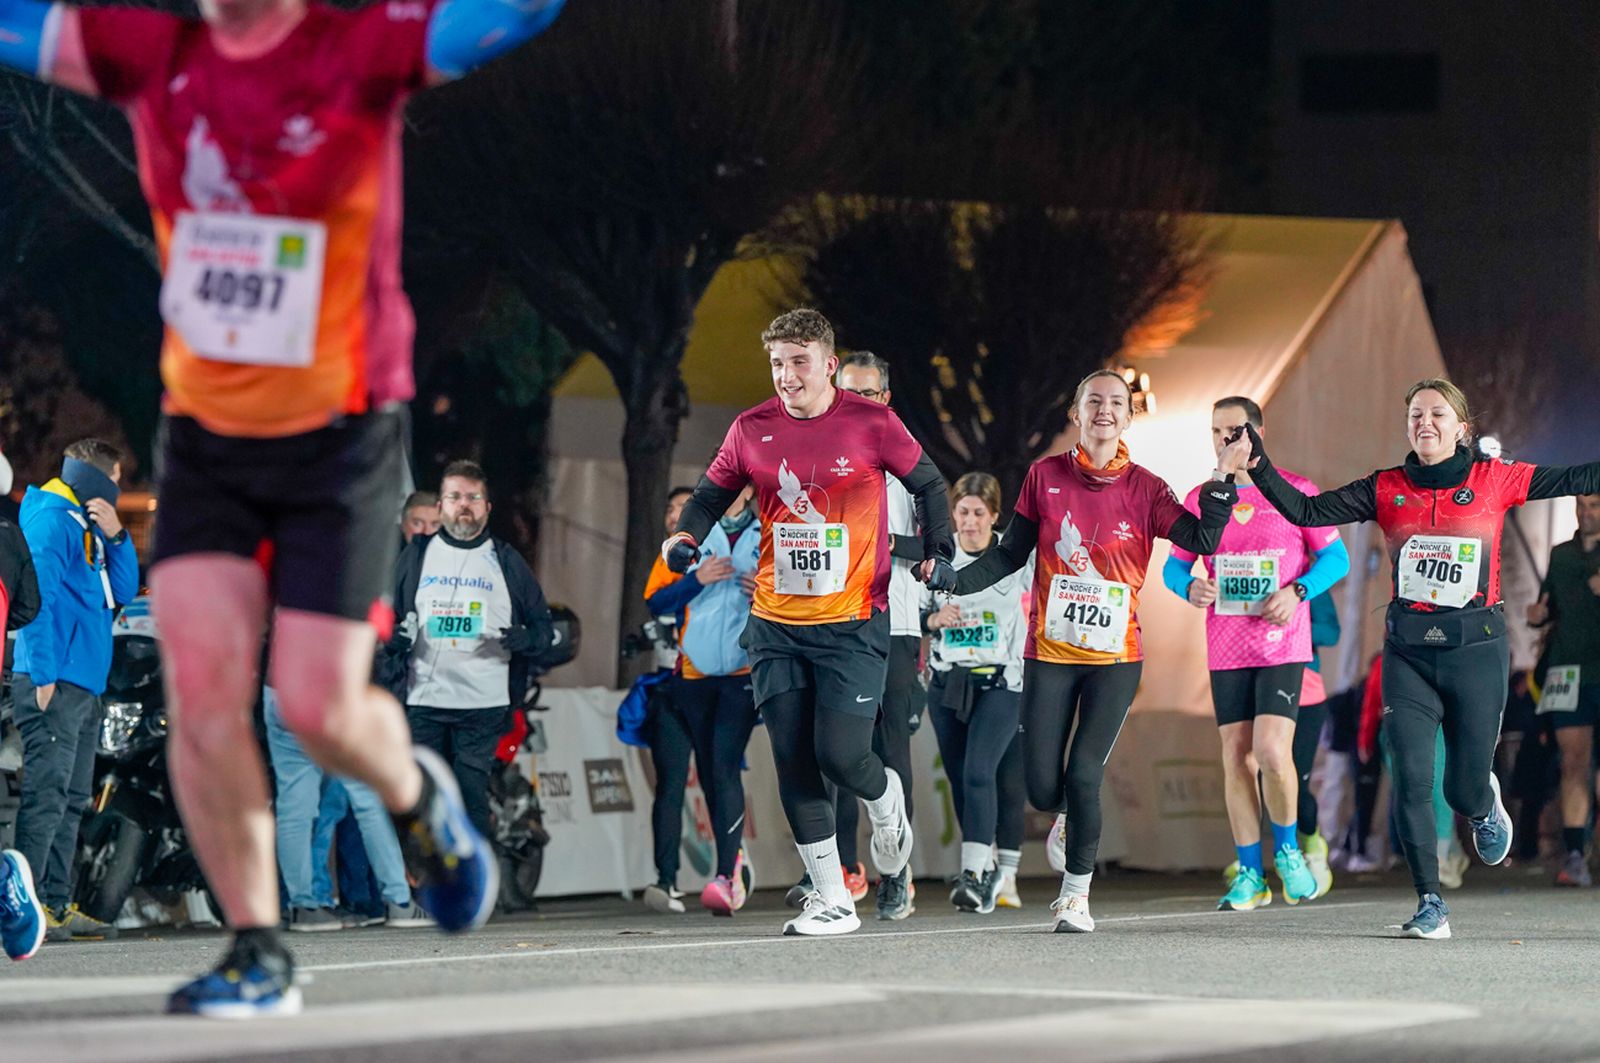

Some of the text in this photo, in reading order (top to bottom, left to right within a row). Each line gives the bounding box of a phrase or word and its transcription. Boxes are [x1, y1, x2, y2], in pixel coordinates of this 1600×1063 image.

[195, 268, 285, 312] 4097
[787, 531, 808, 539] NOCHE
[780, 540, 794, 548] SAN
[788, 549, 831, 571] 1581
[1069, 551, 1088, 572] 43
[1415, 559, 1463, 584] 4706
[440, 576, 493, 591] aqualia
[1069, 584, 1092, 593] NOCHE
[1223, 577, 1271, 595] 13992
[1058, 591, 1074, 600] SAN
[437, 616, 472, 632] 7978
